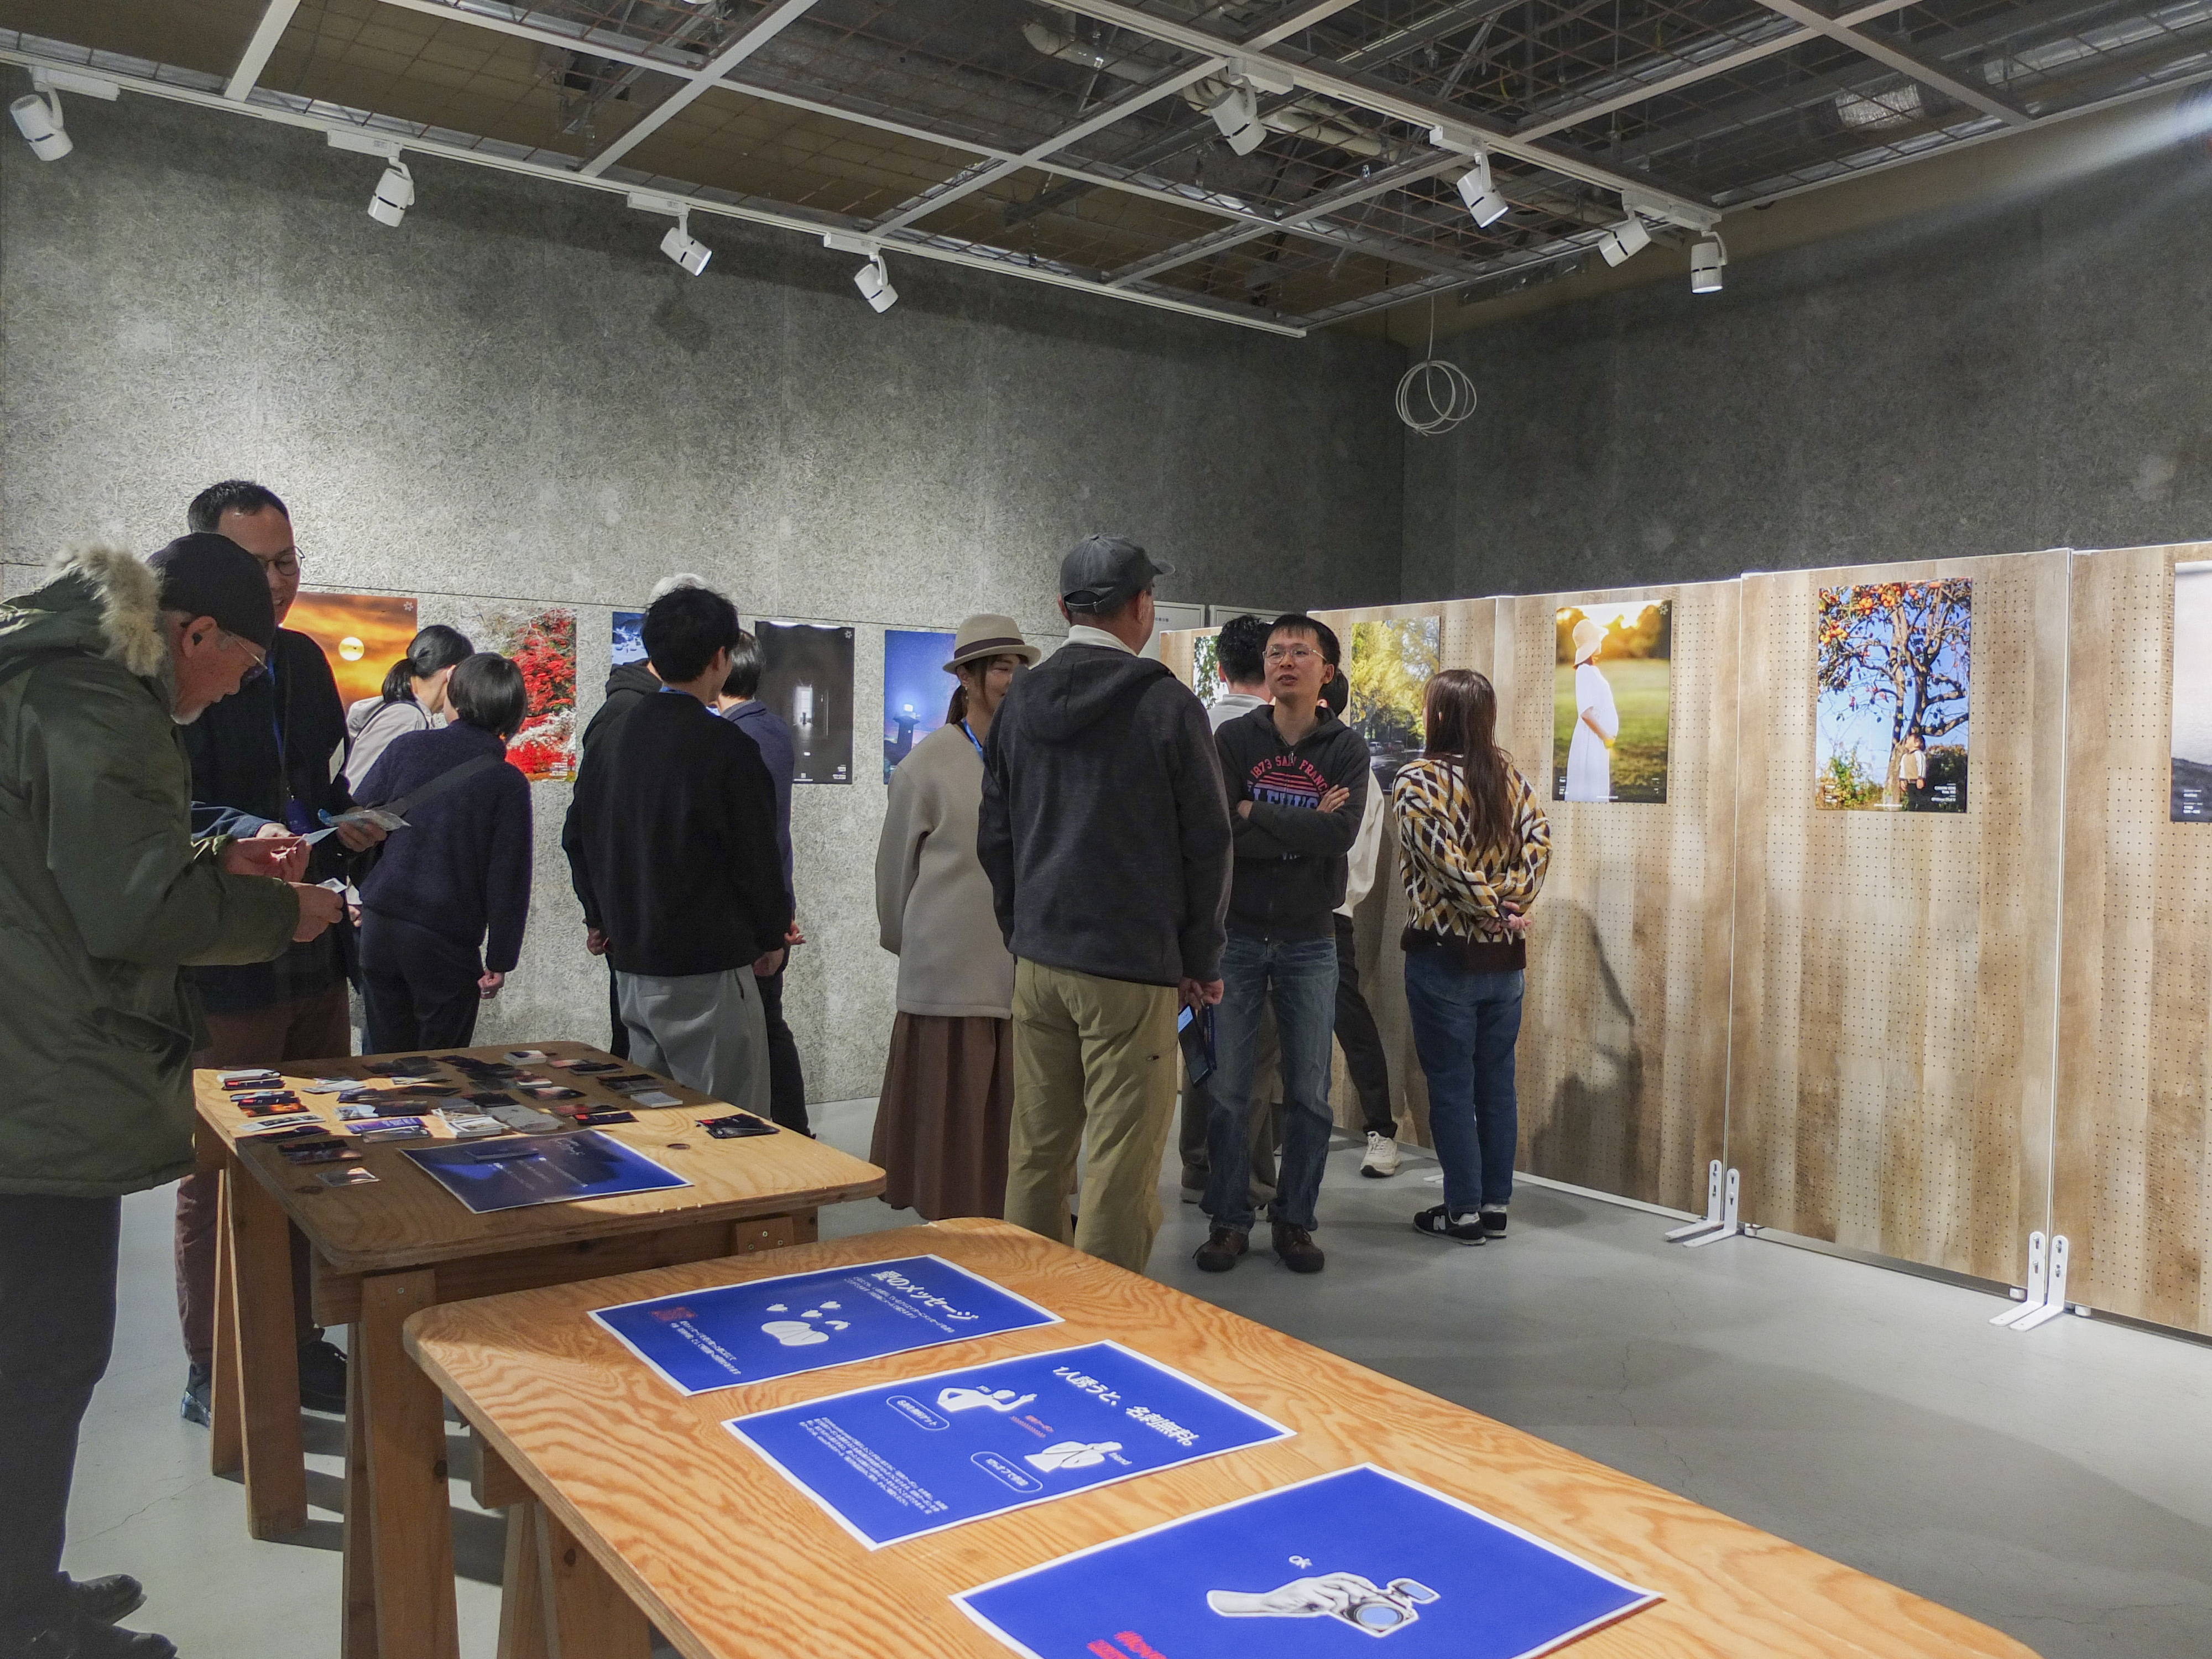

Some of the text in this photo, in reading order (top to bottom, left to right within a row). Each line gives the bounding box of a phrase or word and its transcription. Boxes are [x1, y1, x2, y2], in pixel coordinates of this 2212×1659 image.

[1250, 759, 1272, 779] 1873
[871, 1271, 979, 1320] 愛のメッセージ
